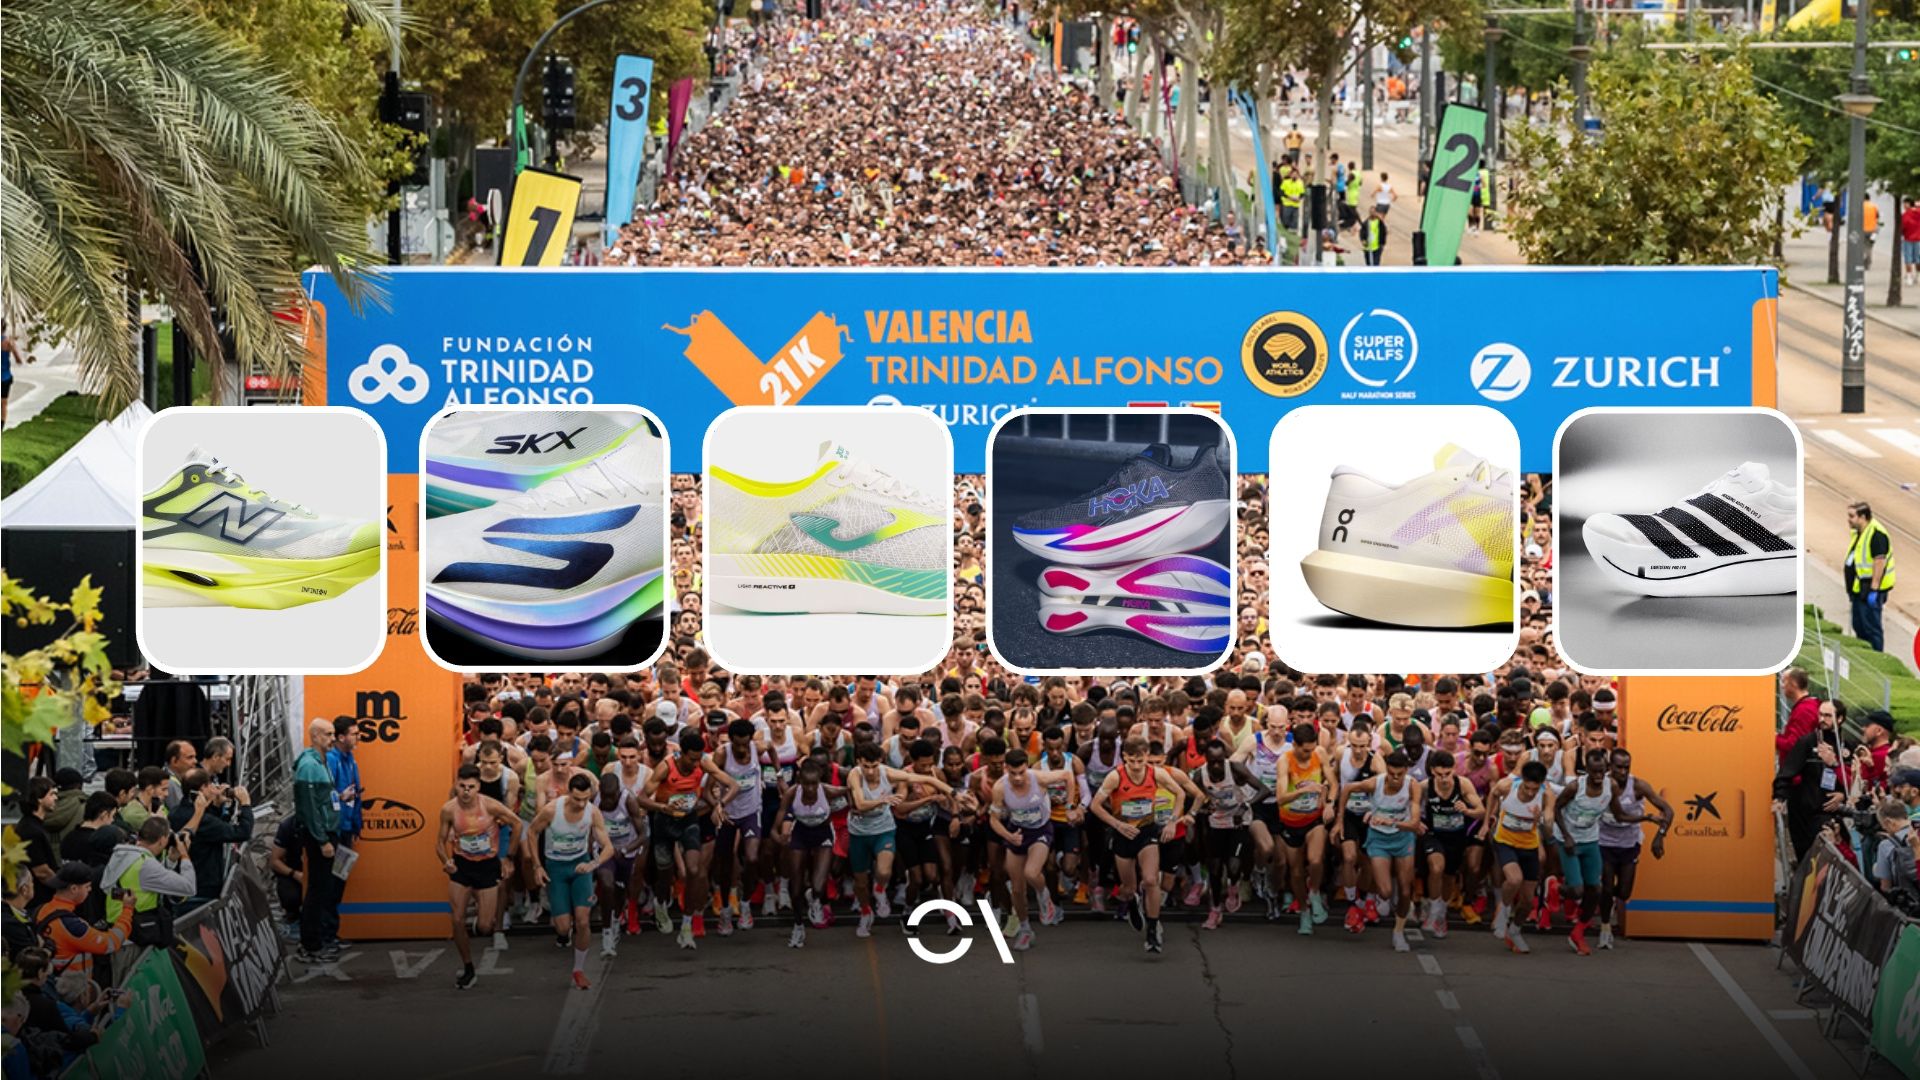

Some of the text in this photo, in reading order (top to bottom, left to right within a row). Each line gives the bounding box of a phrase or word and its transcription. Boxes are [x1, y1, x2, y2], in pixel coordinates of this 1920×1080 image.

[615, 77, 647, 121] 3
[1435, 133, 1480, 192] 2
[520, 206, 562, 267] 1
[864, 310, 1033, 344] VALENCIA
[442, 333, 593, 353] FUNDACIÓN
[1354, 335, 1404, 348] SUPER
[1354, 349, 1404, 361] HALFS
[441, 358, 594, 384] TRINIDAD
[759, 335, 827, 406] 21K
[865, 356, 1224, 386] TRINIDAD ALFONSO
[1265, 369, 1304, 377] ATHLETICS
[1271, 362, 1299, 370] WORLD
[1551, 356, 1720, 388] ZURICH
[484, 426, 589, 455] SKX
[1087, 475, 1170, 517] HOKA
[1121, 598, 1151, 609] HOKA
[1657, 704, 1743, 732] Coca-Cola
[1673, 825, 1729, 837] CaixaBank
